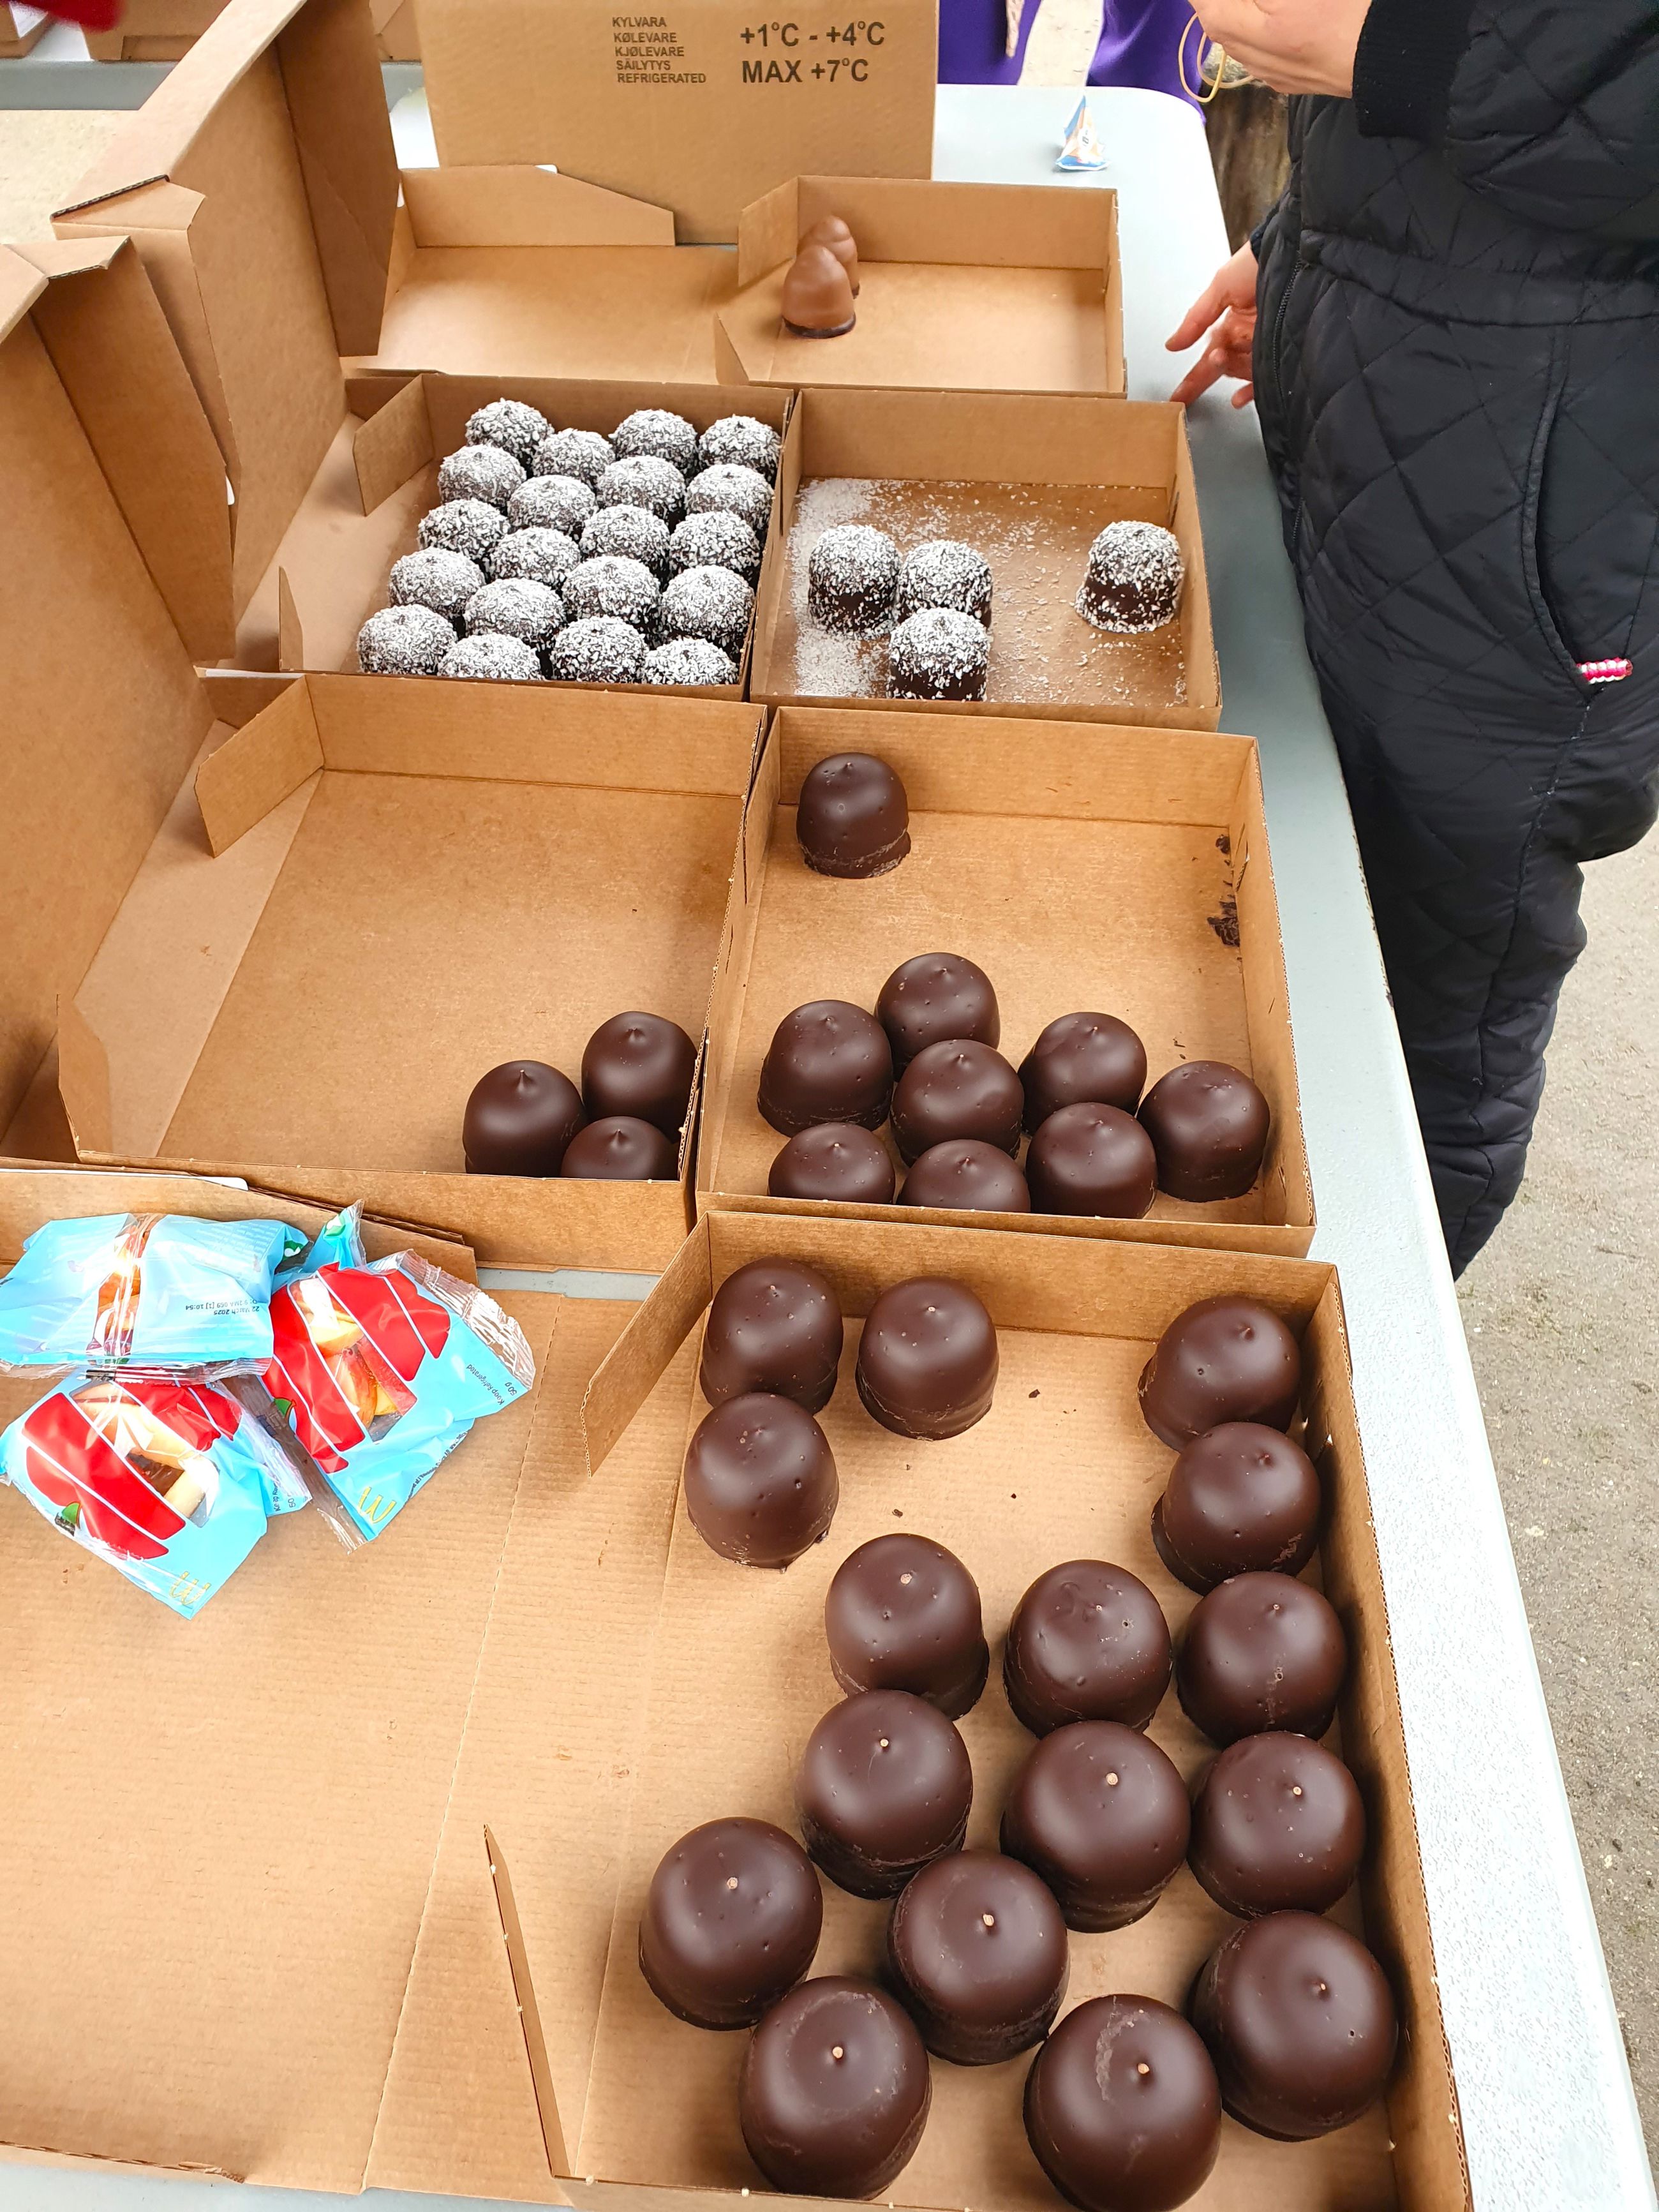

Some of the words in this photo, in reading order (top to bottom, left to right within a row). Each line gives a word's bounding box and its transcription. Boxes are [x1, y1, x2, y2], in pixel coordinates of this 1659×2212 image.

[613, 17, 667, 27] KYLVARA
[614, 32, 677, 43] KØLEVARE
[740, 22, 799, 47] +1°C
[826, 20, 885, 46] +4°C
[615, 46, 685, 57] KJØLEVARE
[616, 58, 671, 70] SÄILYTYS
[742, 59, 803, 83] MAX
[811, 57, 868, 82] +7°C
[618, 73, 706, 84] REFRIGERATED
[466, 1364, 493, 1391] Refrigerated
[507, 1386, 517, 1396] 50
[491, 1389, 505, 1405] Keep
